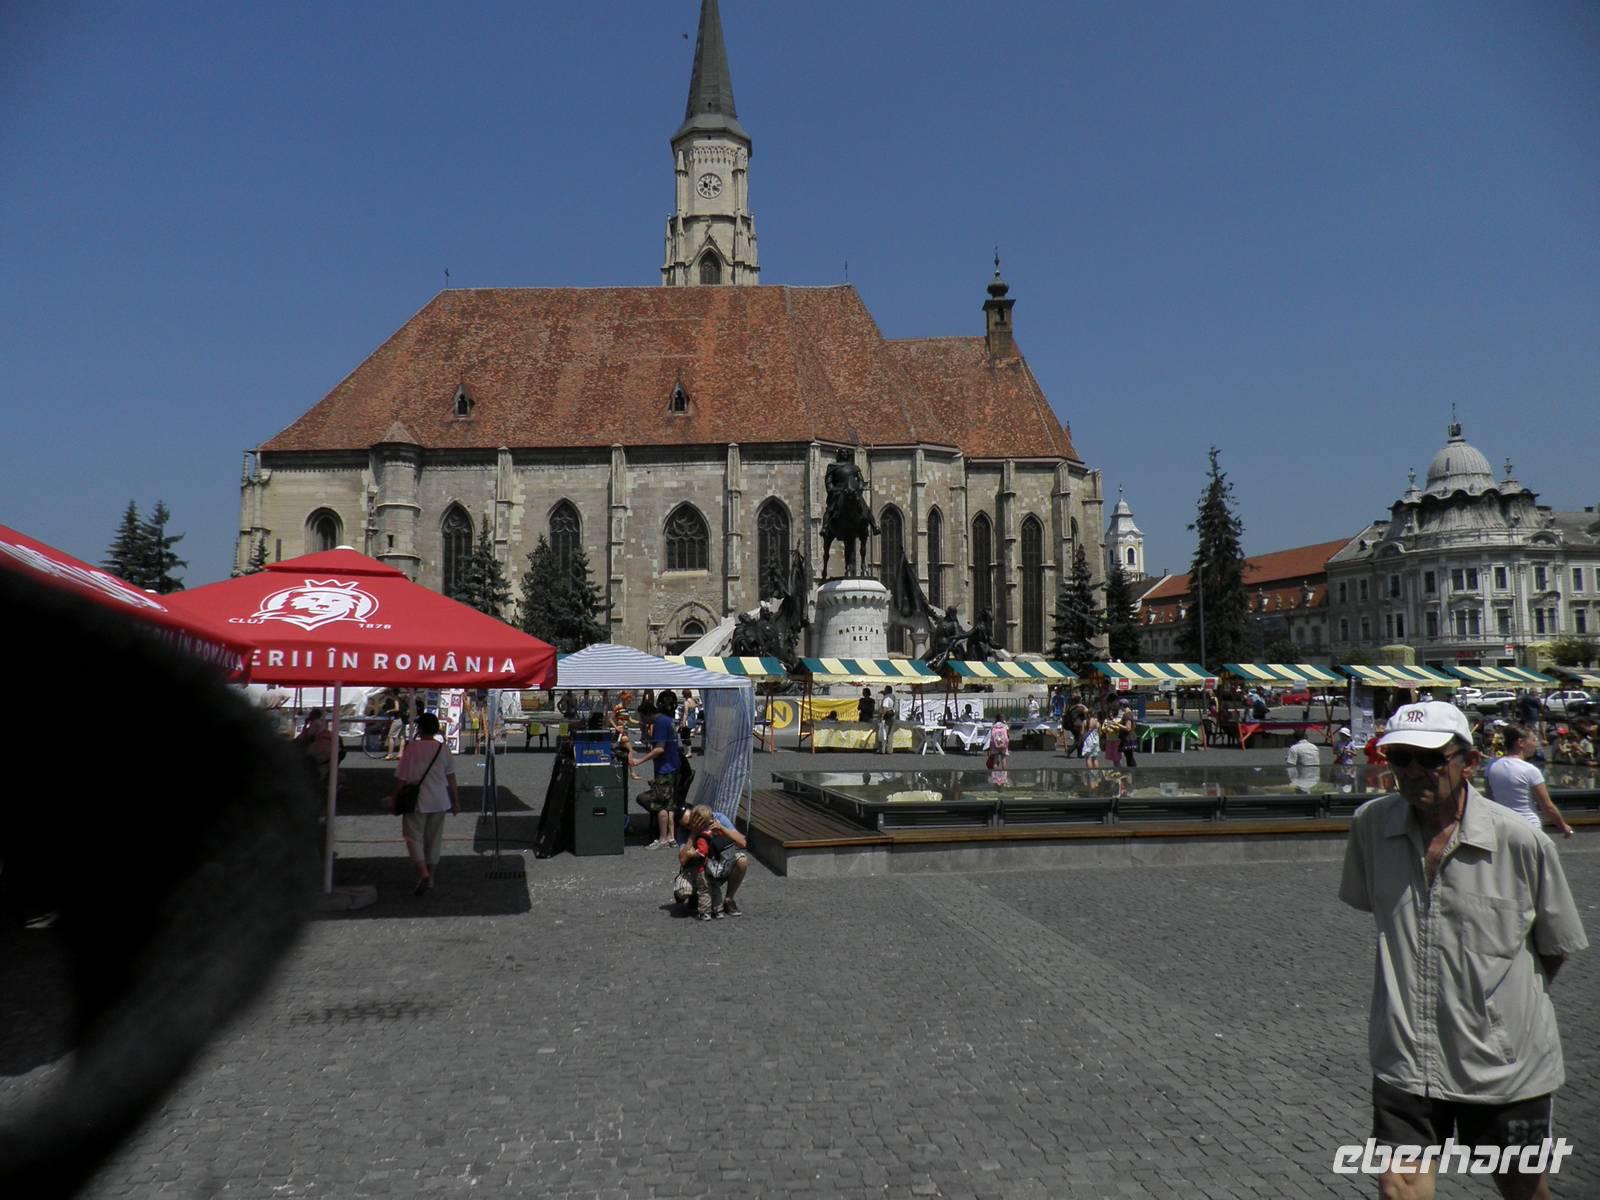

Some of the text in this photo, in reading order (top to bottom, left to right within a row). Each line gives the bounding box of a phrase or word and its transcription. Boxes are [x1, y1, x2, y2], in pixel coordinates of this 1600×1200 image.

[838, 626, 879, 635] MATHIAS
[327, 647, 358, 669] ÎN
[373, 651, 516, 673] ROMÂNIA
[773, 706, 787, 722] N
